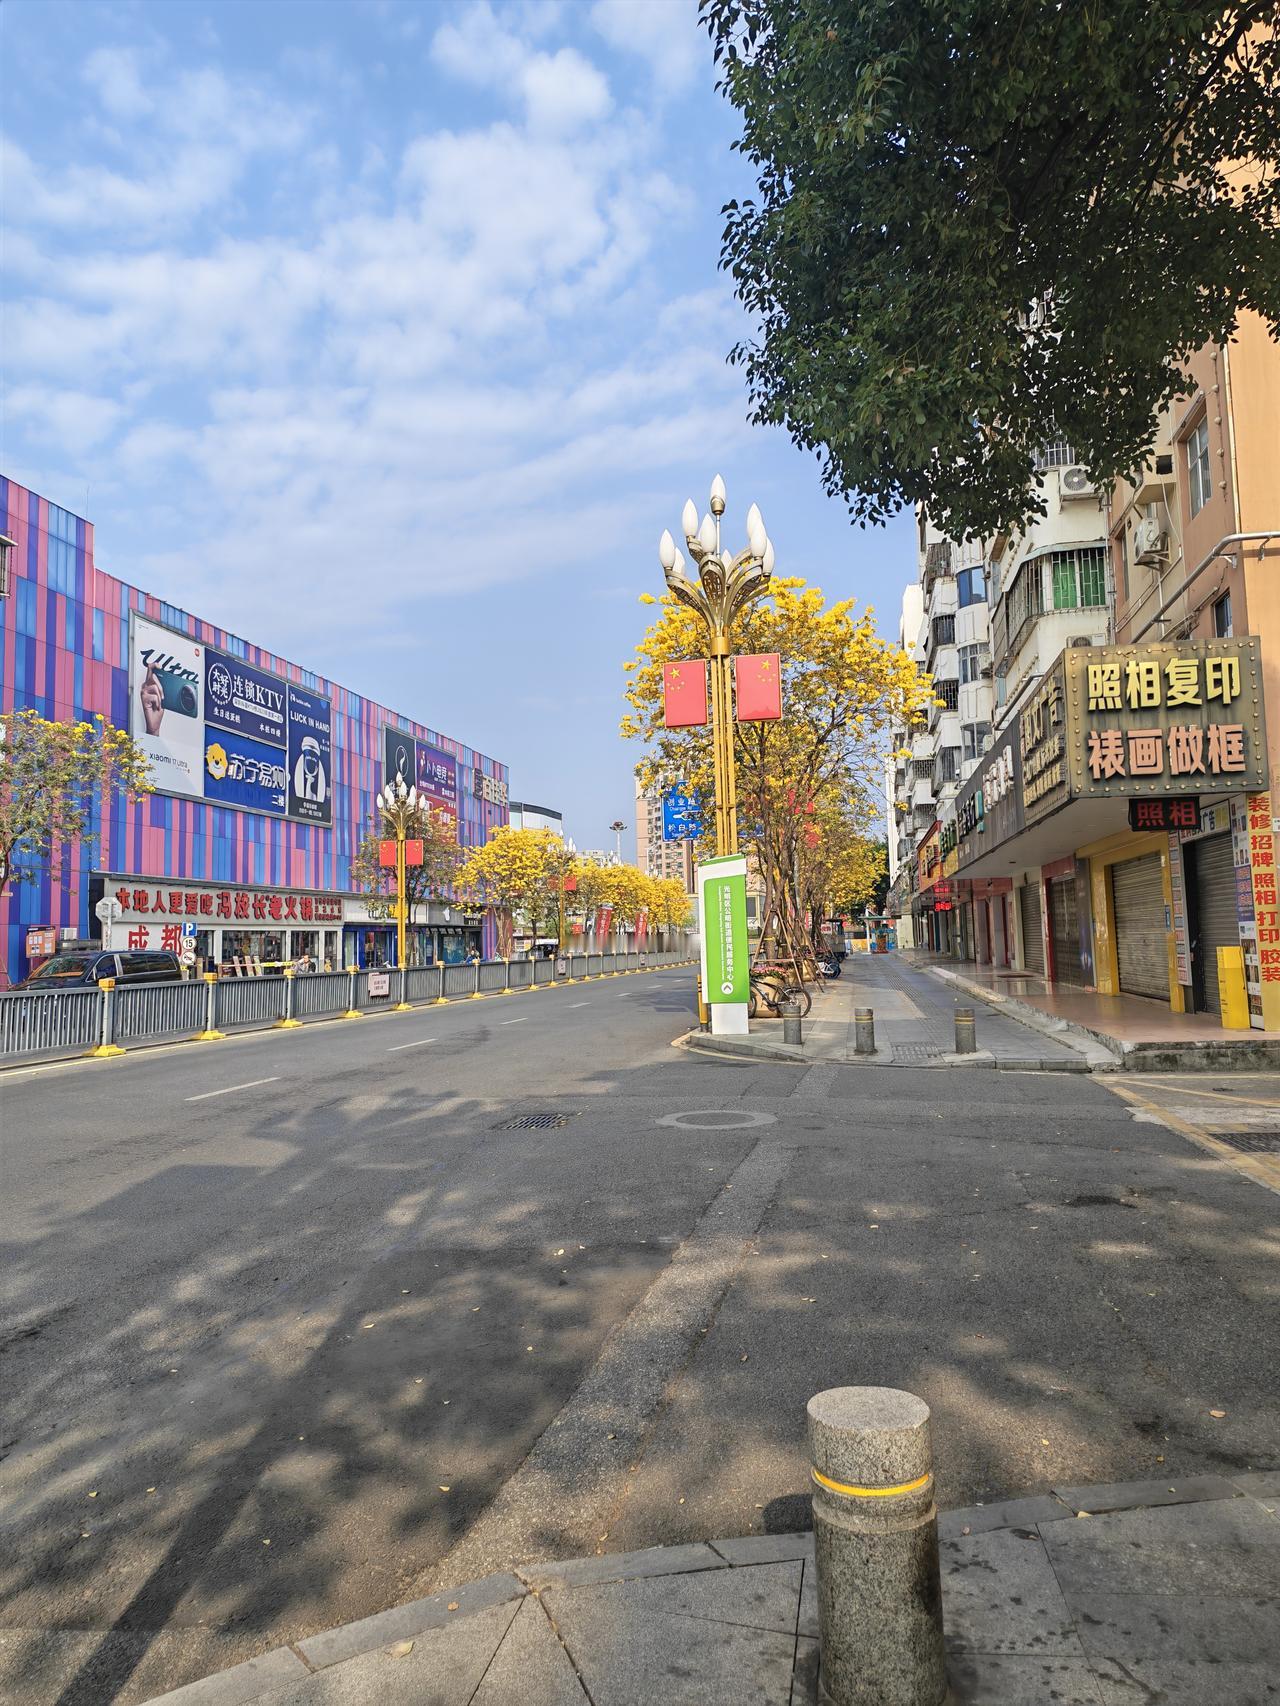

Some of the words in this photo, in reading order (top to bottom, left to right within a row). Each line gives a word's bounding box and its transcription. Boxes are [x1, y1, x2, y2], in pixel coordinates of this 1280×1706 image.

[140, 649, 199, 684] Ultra
[232, 674, 284, 711] 连锁KTV
[1087, 656, 1242, 711] 照相复印
[290, 710, 307, 726] LUCK
[307, 716, 315, 728] IN
[315, 720, 330, 733] HAND
[1088, 724, 1246, 780] 裱画做框
[1137, 800, 1197, 827] 照相
[1248, 797, 1271, 830] 装修
[1250, 834, 1274, 868] 招牌
[1253, 872, 1277, 905] 照相
[128, 922, 183, 957] 成都
[185, 924, 194, 935] P
[1257, 910, 1280, 943] 打印
[184, 939, 193, 948] 15
[1260, 949, 1280, 982] 胶装
